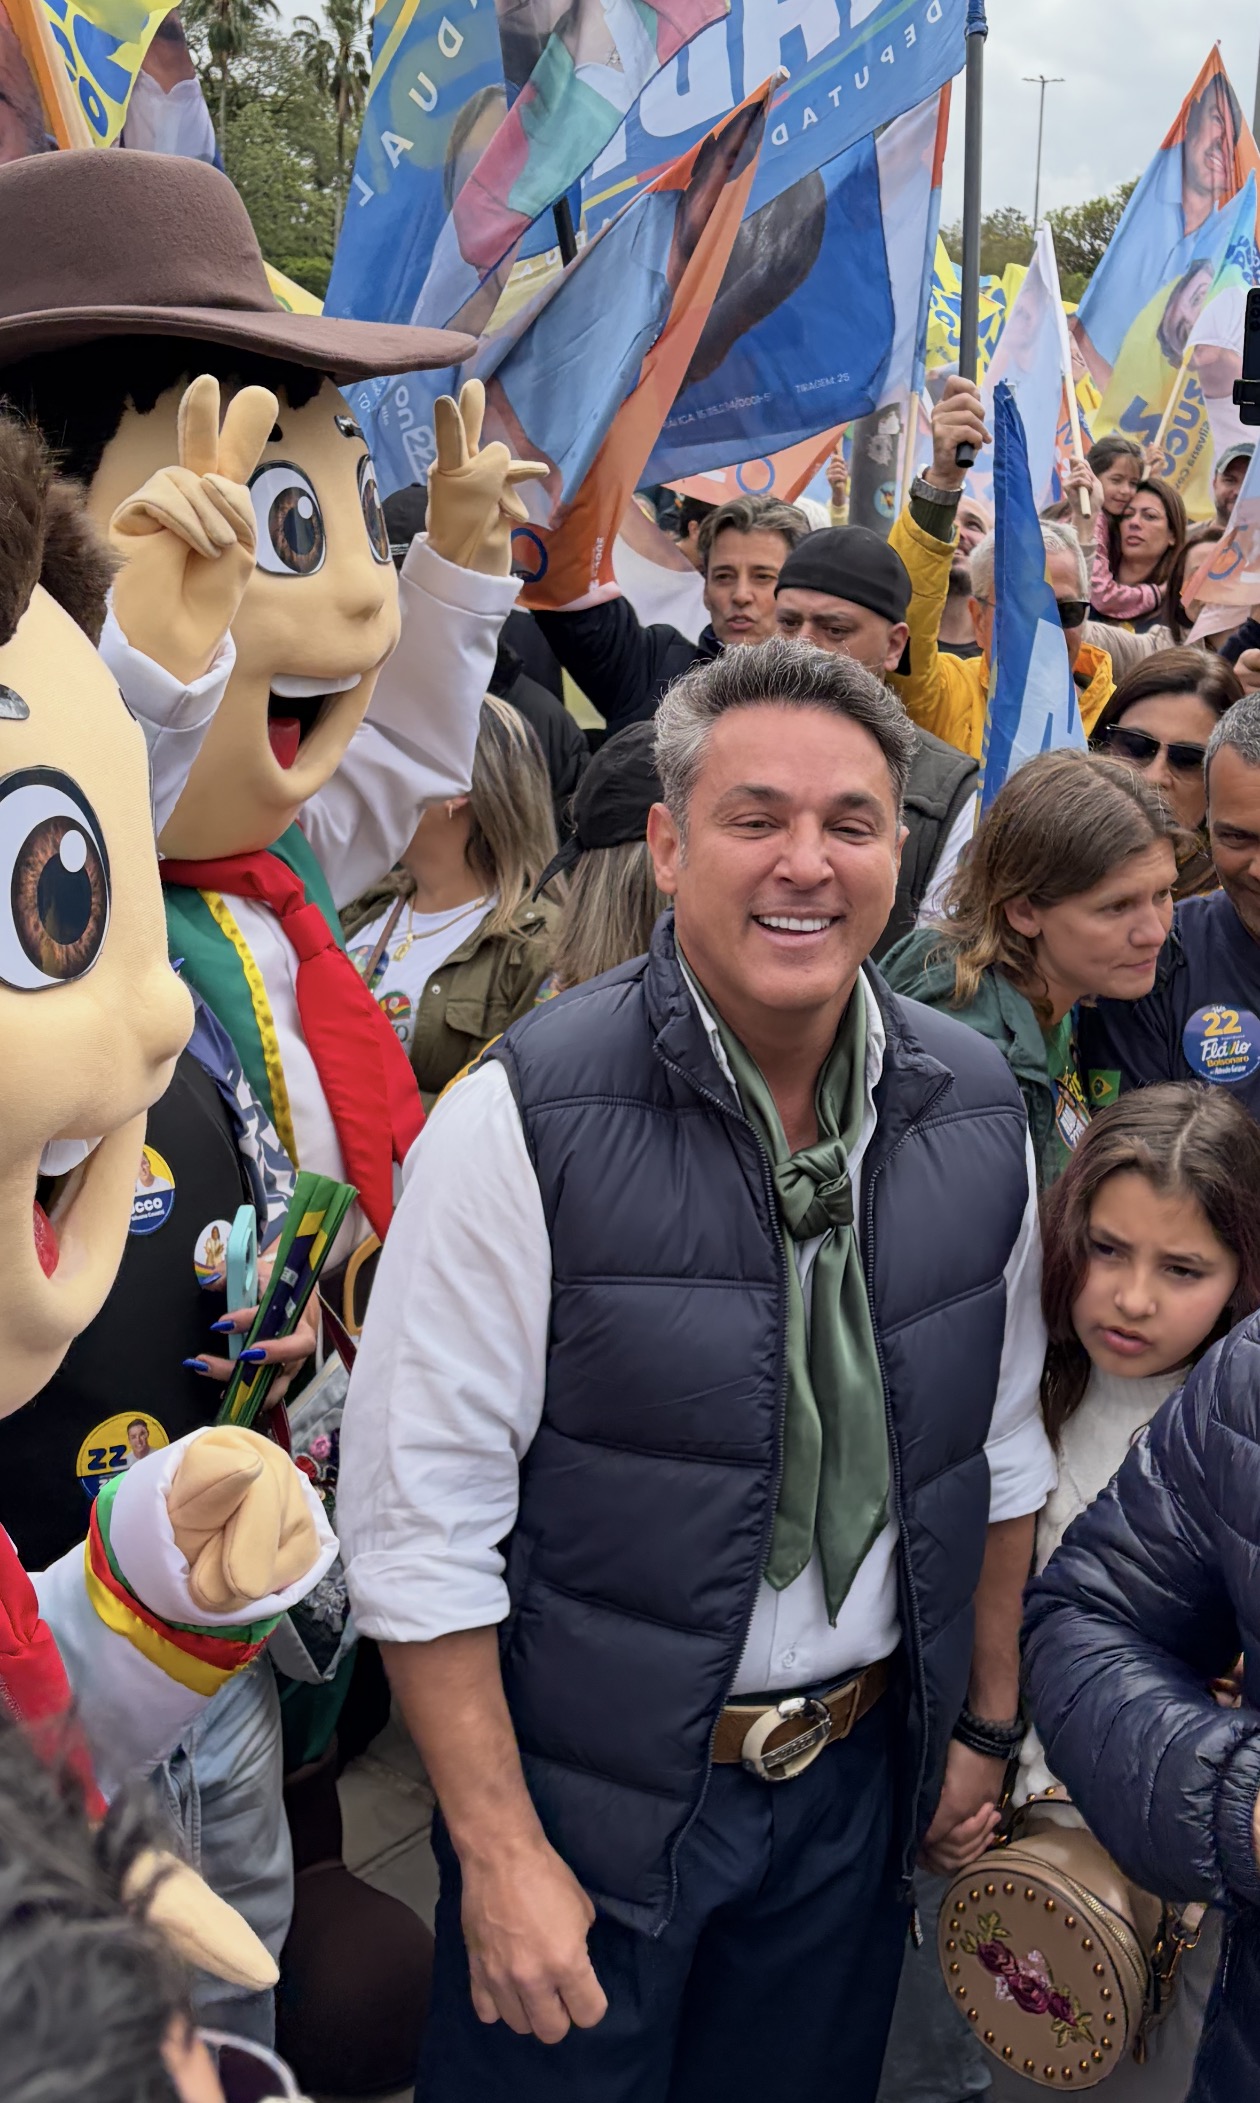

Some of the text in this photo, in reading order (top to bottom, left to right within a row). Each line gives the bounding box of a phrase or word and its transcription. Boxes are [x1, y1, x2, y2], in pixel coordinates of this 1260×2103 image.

[1202, 1009, 1242, 1037] 22
[1200, 1037, 1252, 1061] Flávio
[1206, 1055, 1250, 1068] Bolsonaro
